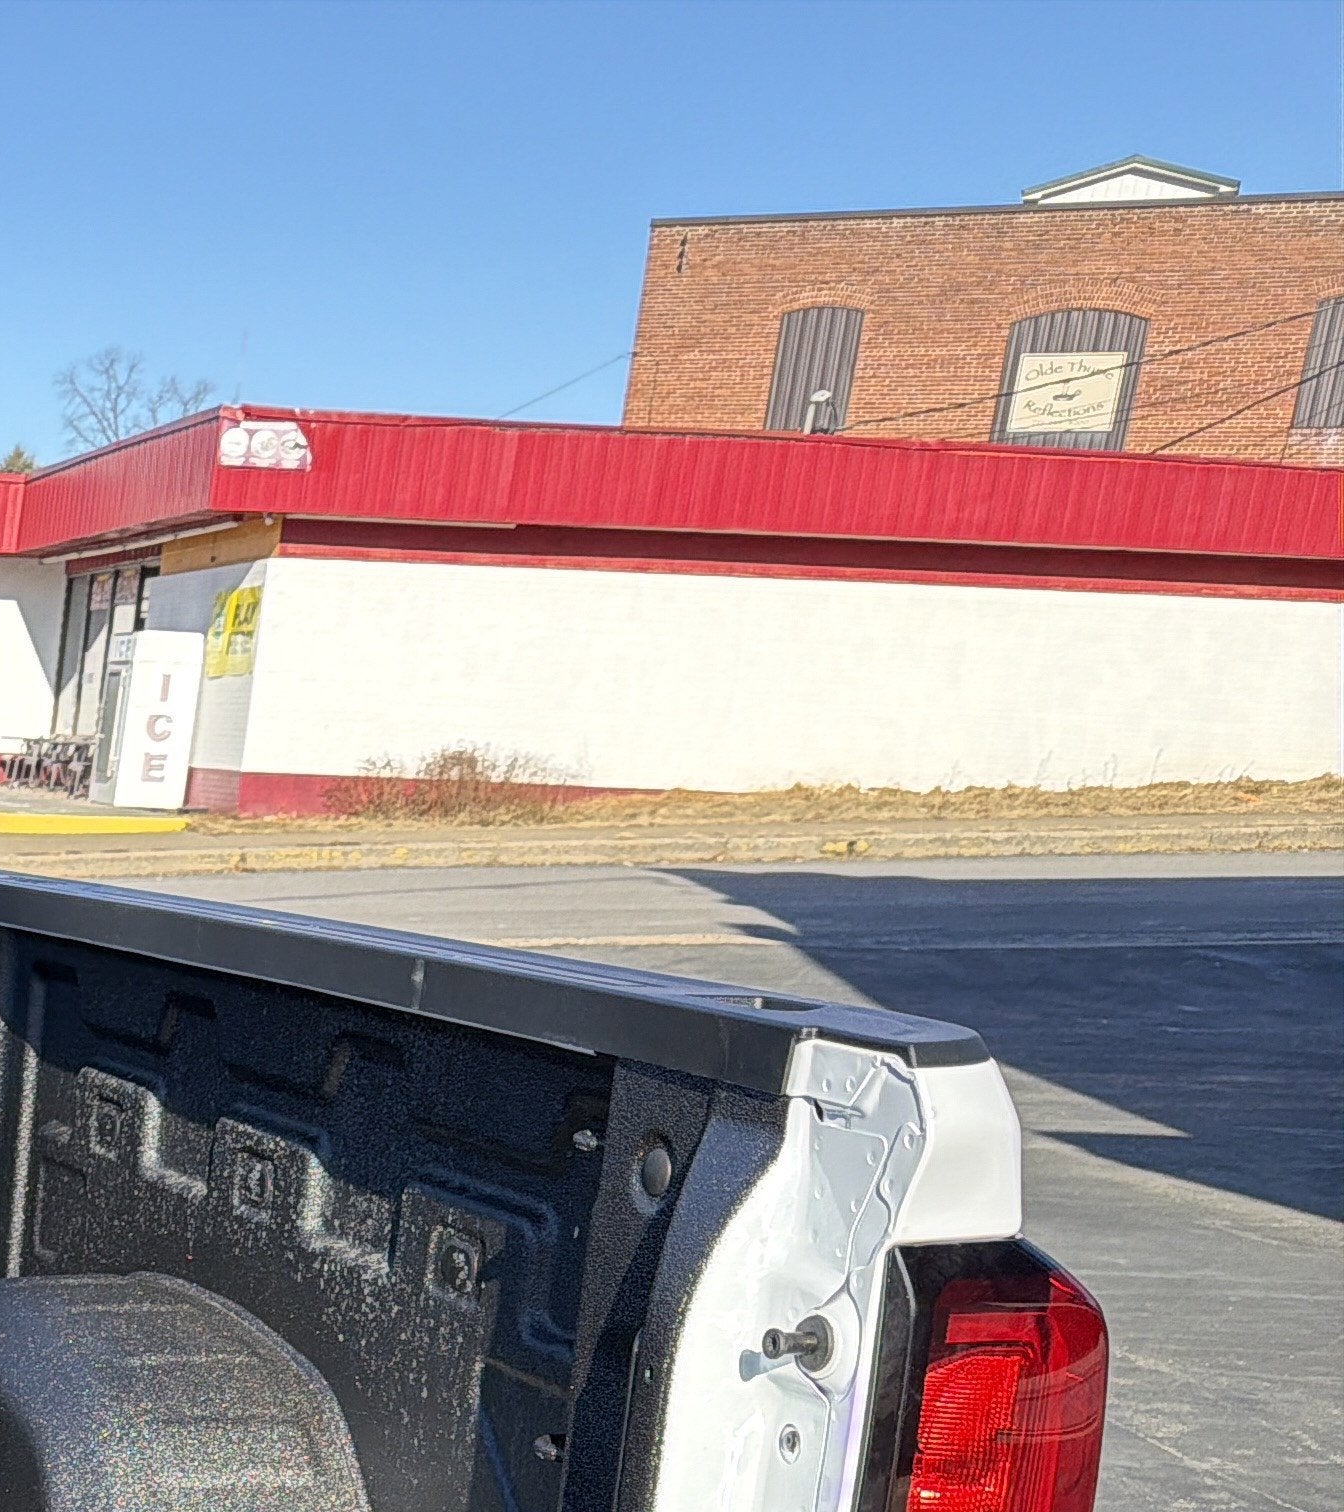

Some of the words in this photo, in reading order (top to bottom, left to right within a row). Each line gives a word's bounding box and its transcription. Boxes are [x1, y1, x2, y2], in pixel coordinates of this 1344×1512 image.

[1025, 361, 1063, 381] Olde
[1022, 400, 1105, 418] Reflections
[141, 673, 173, 783] ICE
